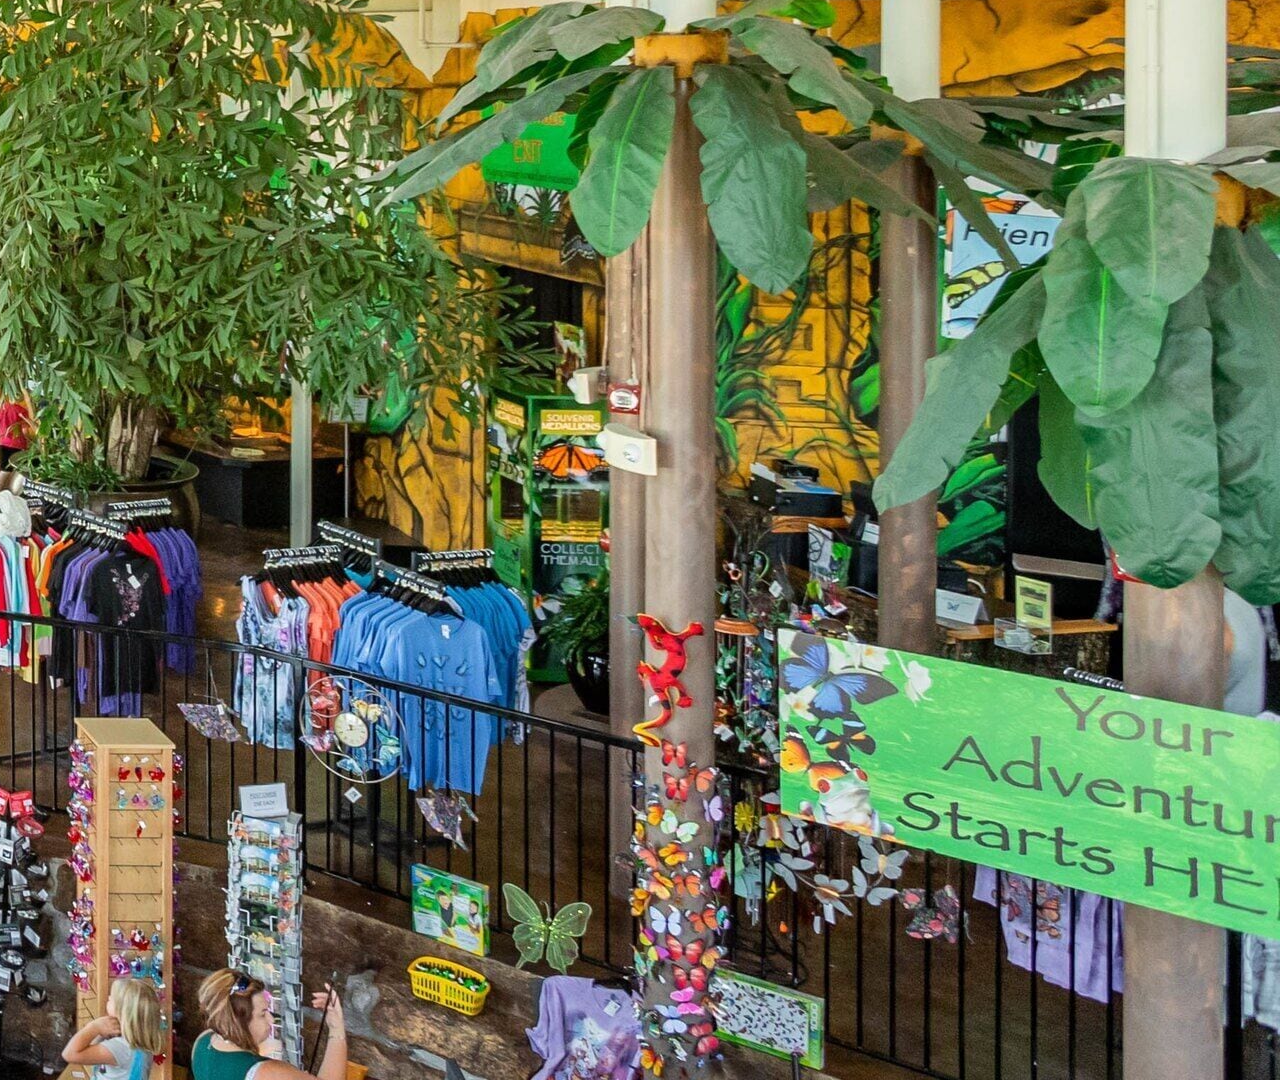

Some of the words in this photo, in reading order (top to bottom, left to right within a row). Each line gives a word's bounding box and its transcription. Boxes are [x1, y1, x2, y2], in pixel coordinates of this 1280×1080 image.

[963, 222, 1050, 247] Fien
[546, 413, 595, 423] SOUVENIR
[541, 422, 602, 432] MEDALLIONS
[540, 543, 601, 554] COLLECT
[541, 555, 578, 566] THEM
[1056, 686, 1234, 756] Your
[896, 791, 1116, 876] Starts
[1143, 845, 1280, 920] HE
